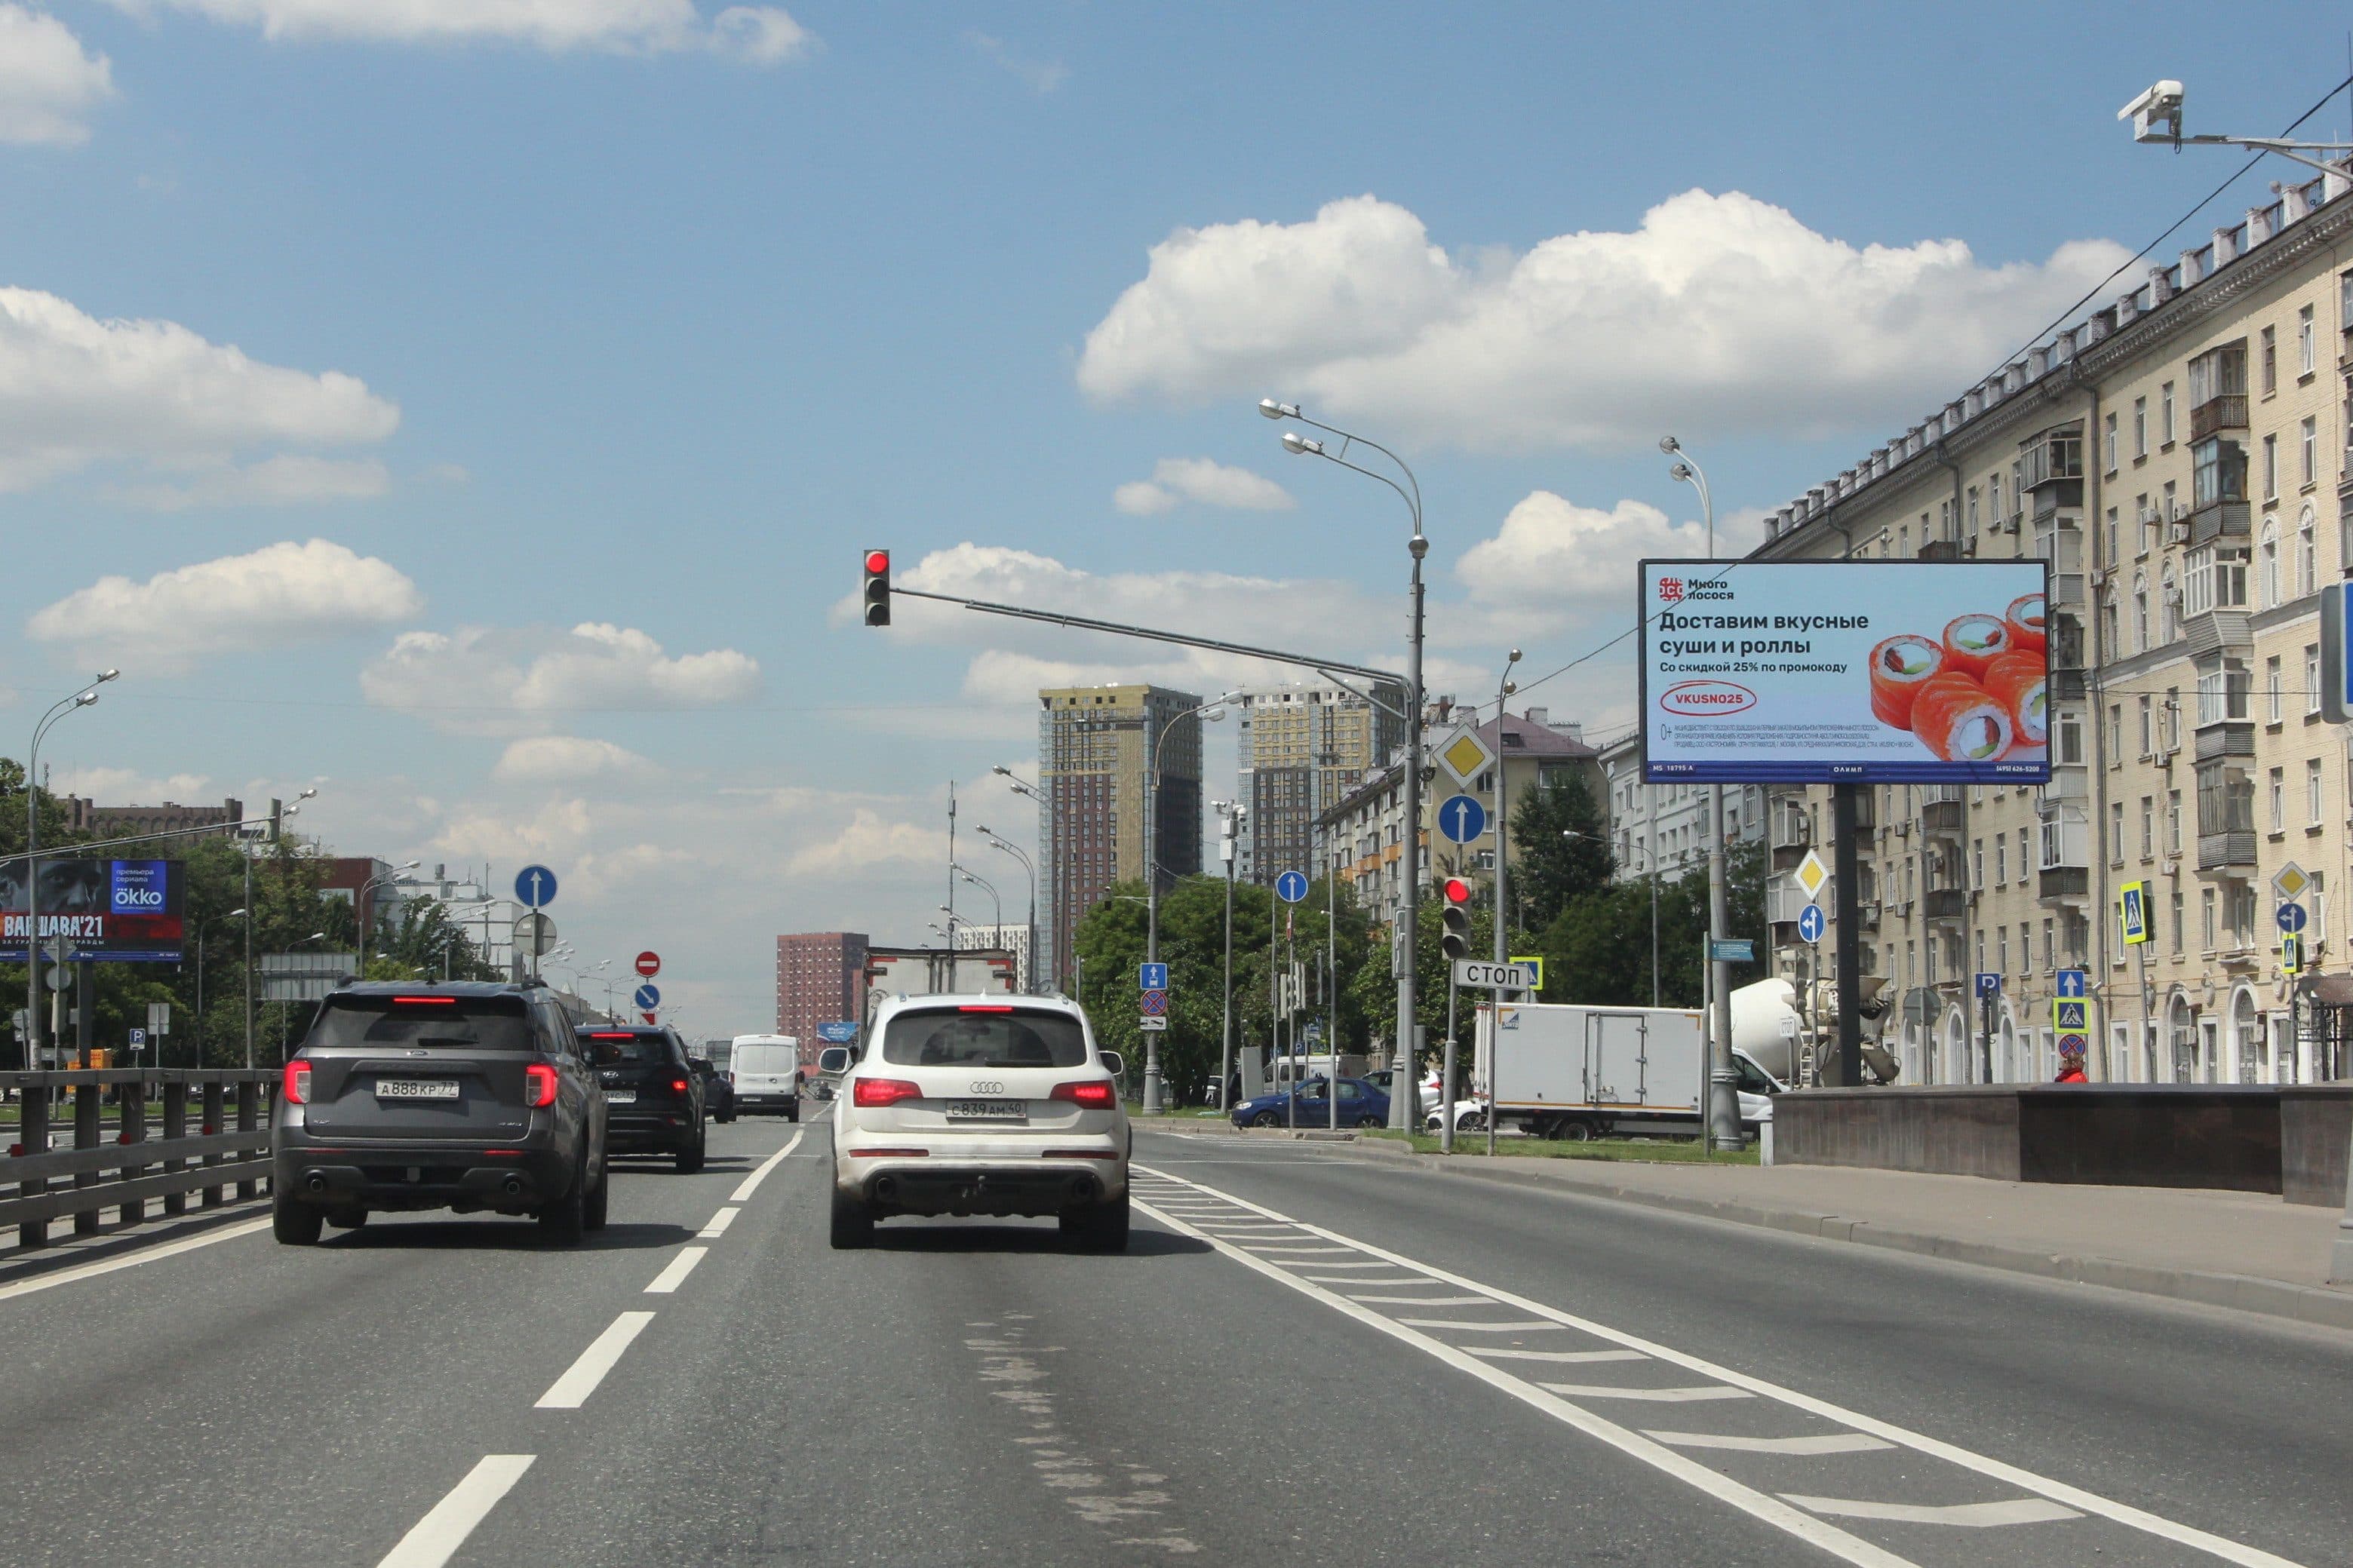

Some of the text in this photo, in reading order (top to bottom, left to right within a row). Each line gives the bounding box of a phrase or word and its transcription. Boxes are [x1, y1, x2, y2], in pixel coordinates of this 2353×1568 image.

[1688, 579, 1728, 588] Много
[1688, 591, 1734, 600] лосося
[1660, 612, 1869, 632] Доставим вкусные
[1660, 640, 1810, 657] суши и роллы
[1660, 661, 1848, 674] Со скидкой 25% по промокоду
[1676, 694, 1743, 704] VKUSNO25
[1660, 723, 1672, 741] 0+
[1467, 965, 1519, 985] СТОП
[134, 1030, 143, 1042] P
